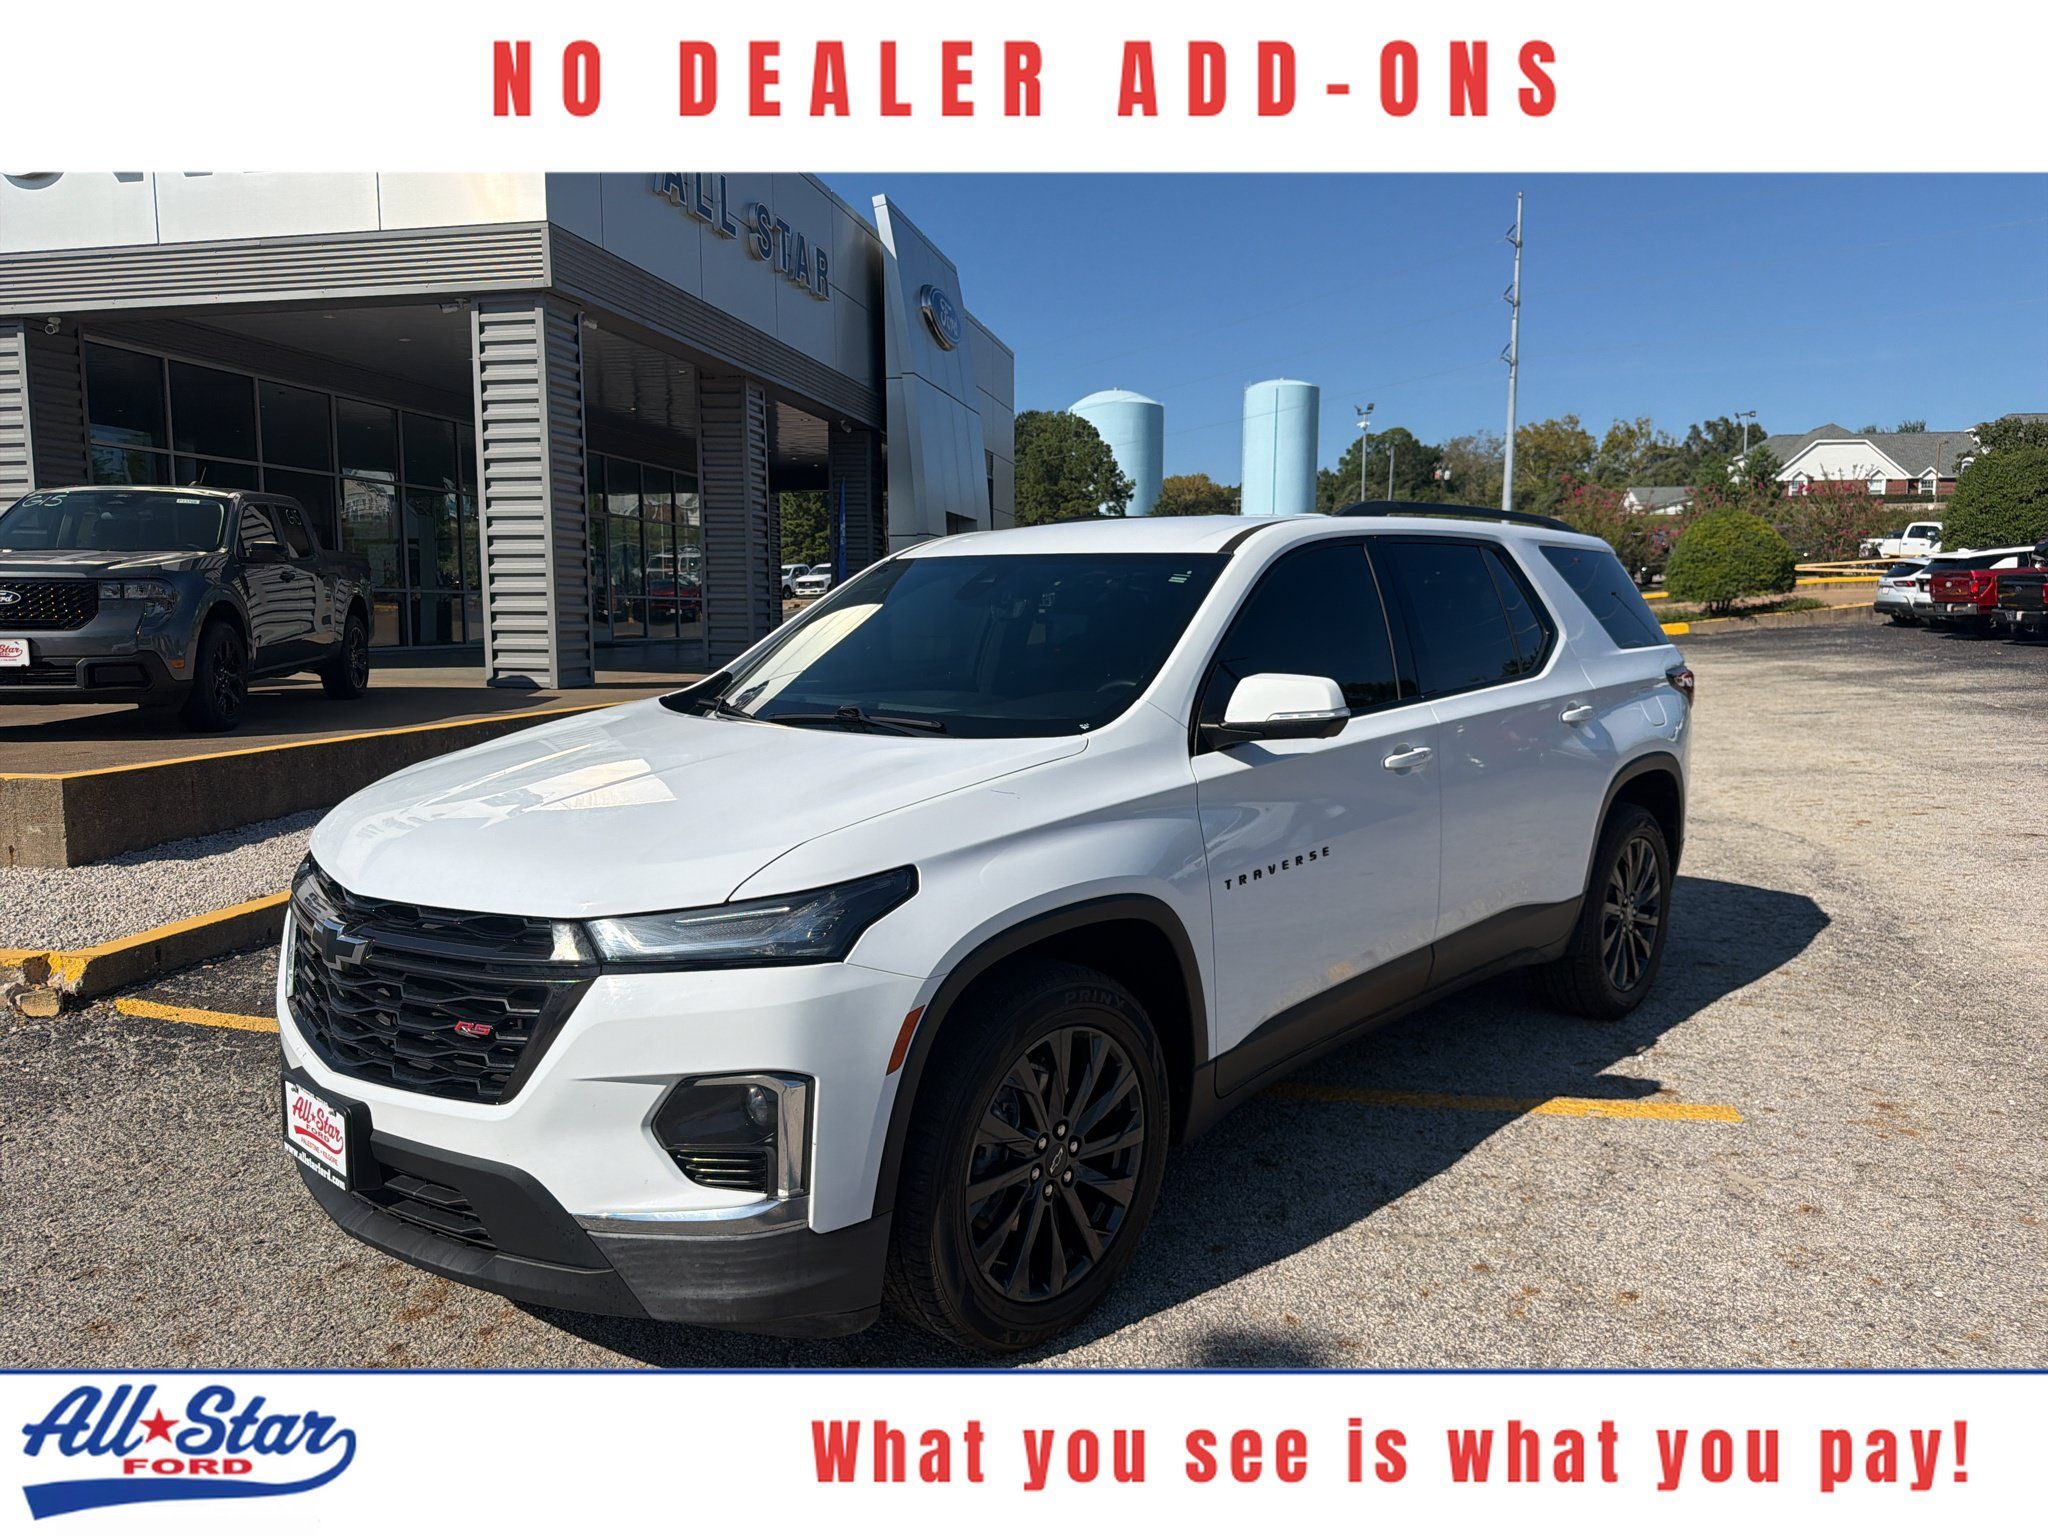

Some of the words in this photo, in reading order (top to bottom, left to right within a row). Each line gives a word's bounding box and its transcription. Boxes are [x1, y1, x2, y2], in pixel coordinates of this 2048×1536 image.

[748, 201, 830, 302] STAR
[1224, 846, 1331, 891] TRAVERSE
[454, 1020, 493, 1036] RS
[292, 1096, 313, 1124] All
[315, 1107, 342, 1143] Star
[305, 1123, 331, 1143] FORD
